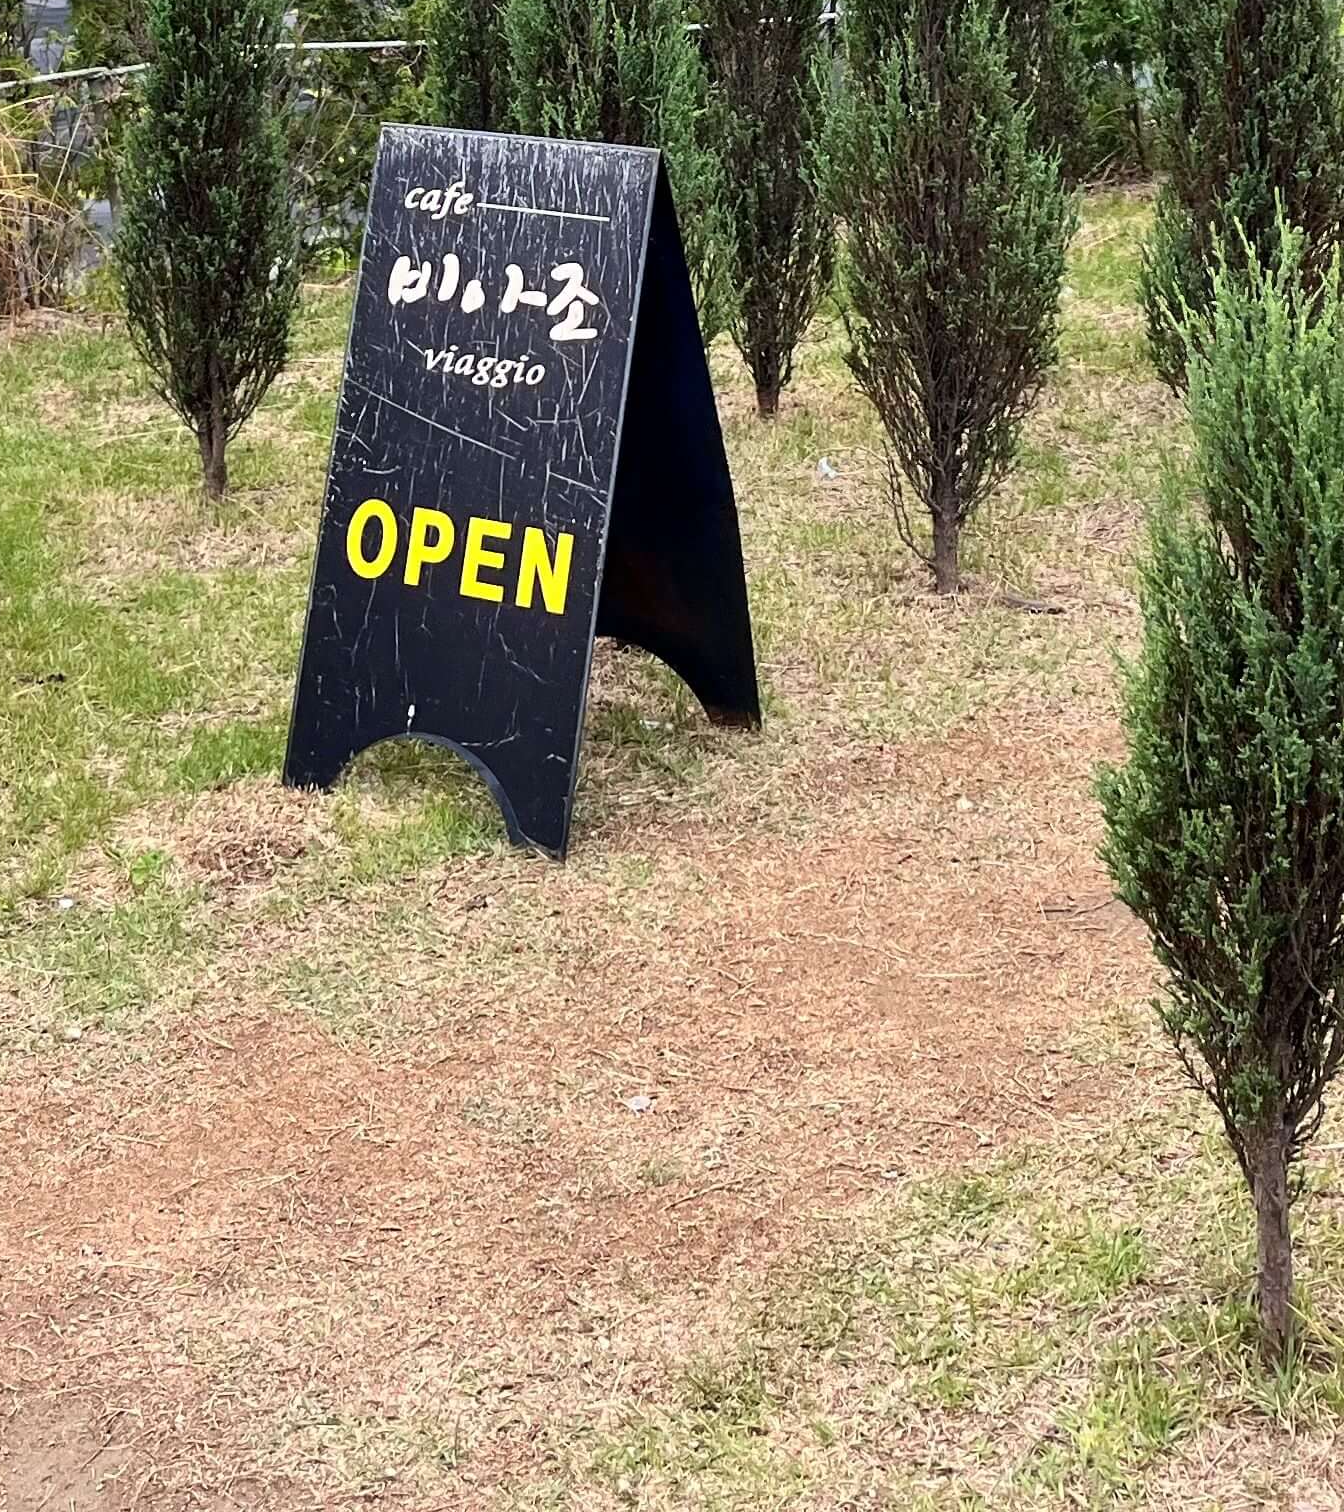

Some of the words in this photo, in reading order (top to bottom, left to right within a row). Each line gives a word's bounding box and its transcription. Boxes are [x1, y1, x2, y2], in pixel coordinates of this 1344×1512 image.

[405, 180, 474, 220] cafe
[423, 345, 546, 388] viaggio
[346, 499, 575, 615] OPEN
